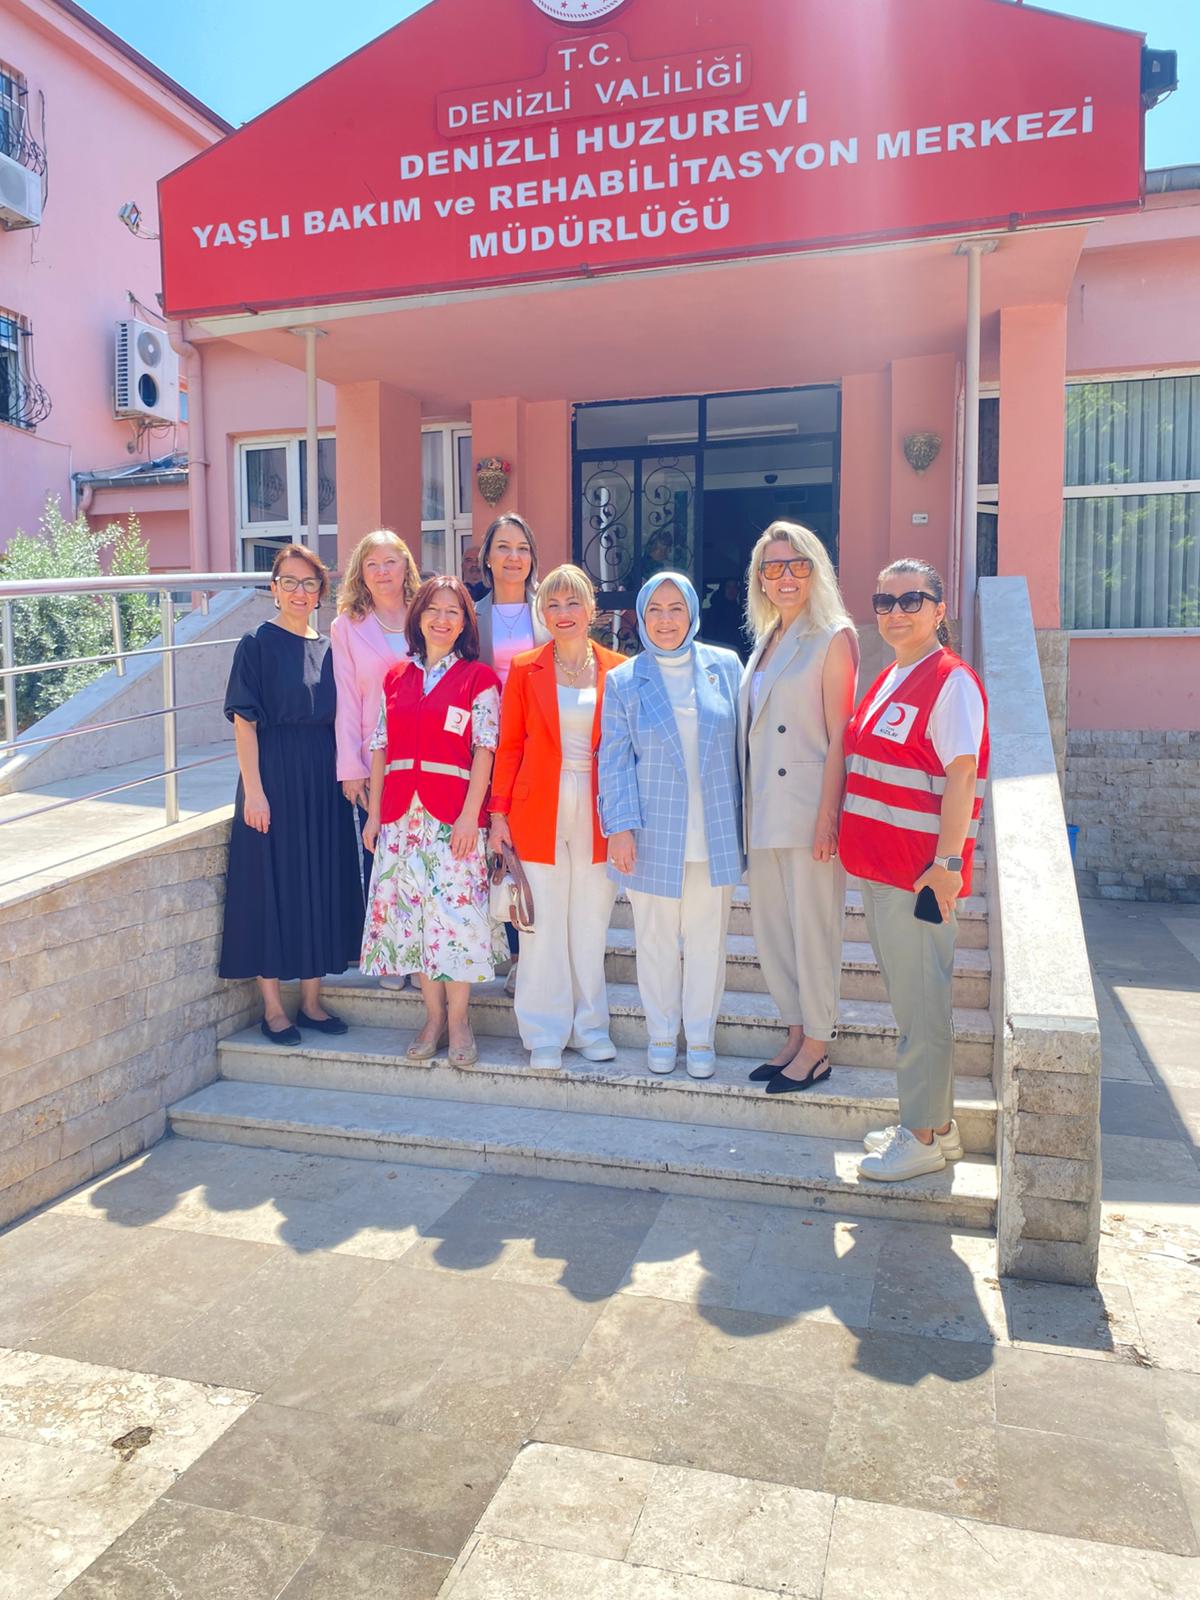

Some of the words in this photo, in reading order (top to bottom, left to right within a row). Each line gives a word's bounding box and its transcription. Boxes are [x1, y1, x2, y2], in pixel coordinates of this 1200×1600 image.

[448, 81, 570, 128] DENİZLİ
[595, 53, 742, 105] VALİLİĞİ
[558, 43, 621, 71] T.C.
[193, 215, 290, 248] YAŞLI
[304, 198, 421, 235] BAKIM
[434, 197, 475, 218] ve
[489, 137, 858, 211] REHABİLİTASYON
[876, 97, 1093, 161] MERKEZİ
[400, 128, 559, 180] DENİZLİ
[577, 91, 808, 154] HUZUREVİ
[469, 198, 730, 259] MÜDÜRLÜĞÜ
